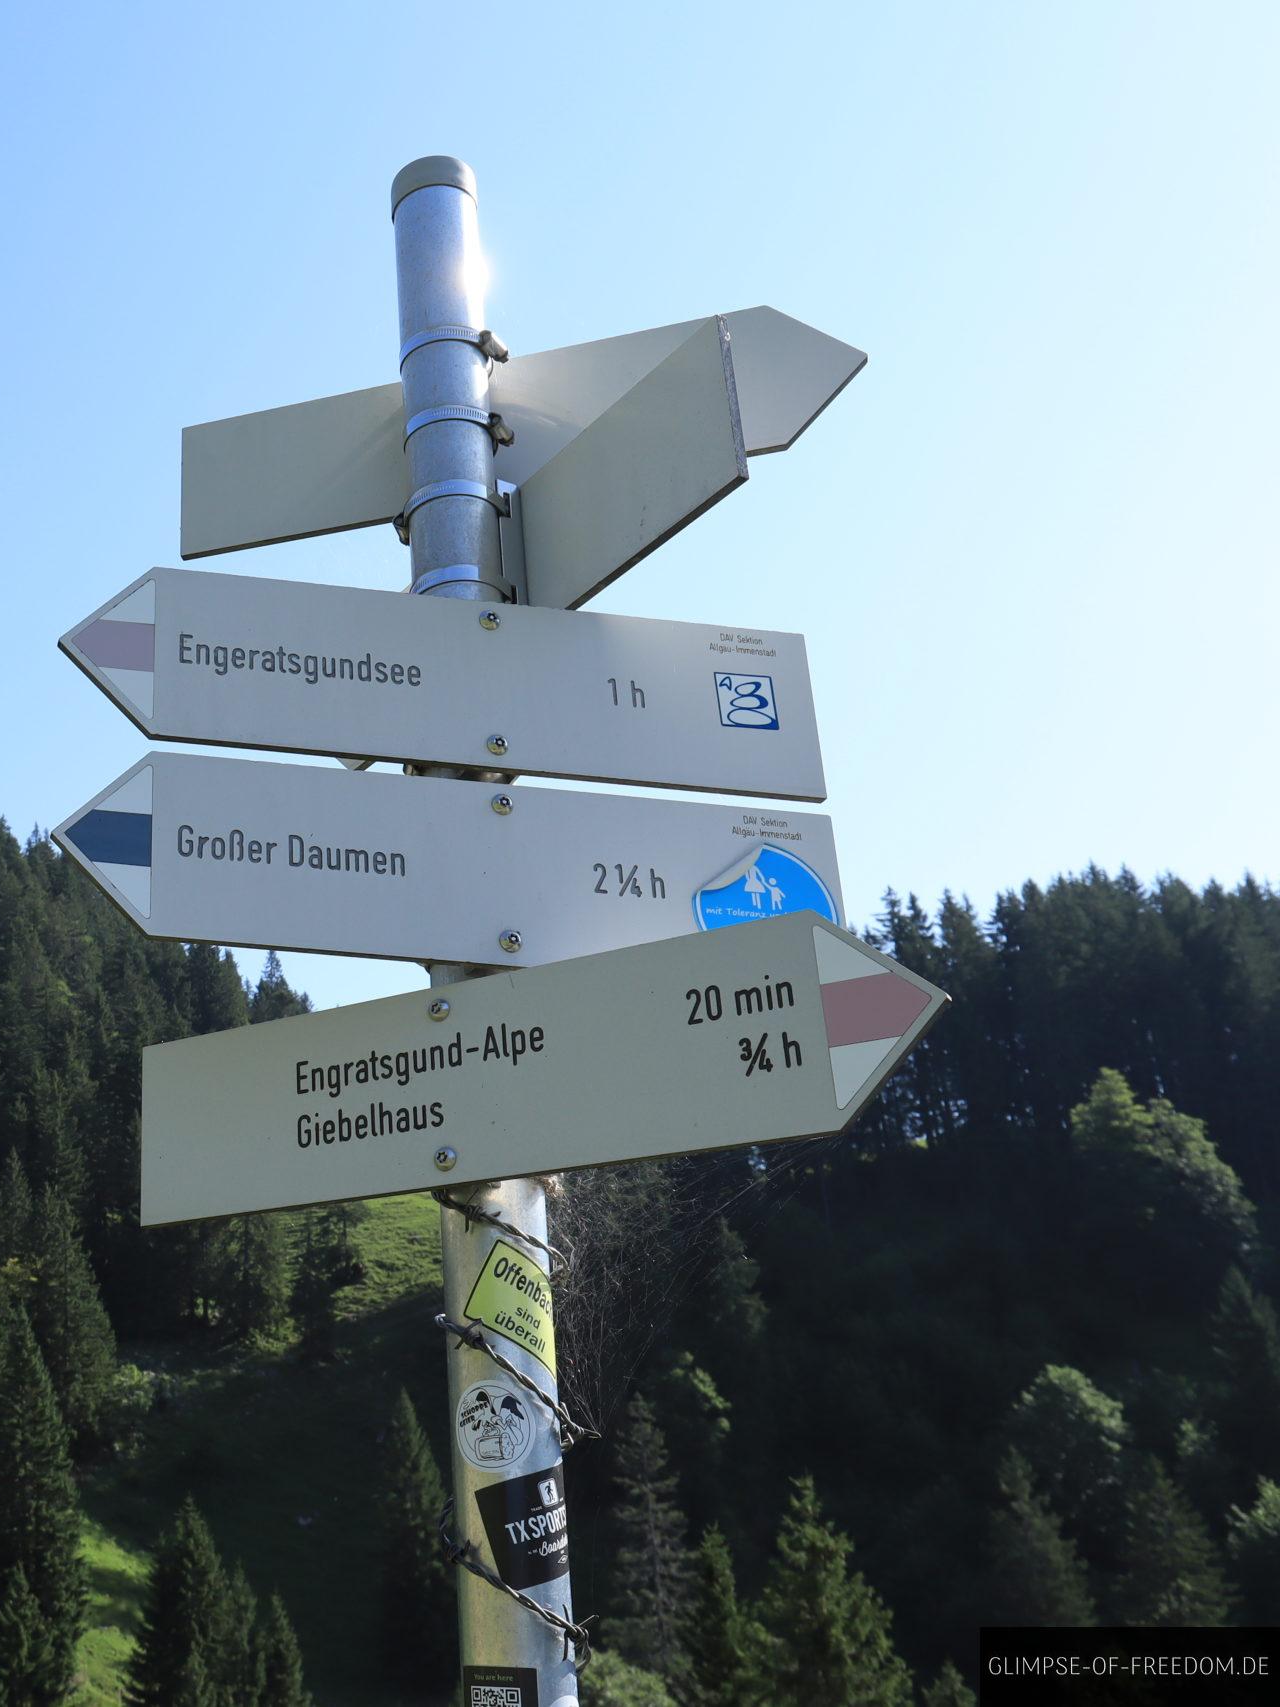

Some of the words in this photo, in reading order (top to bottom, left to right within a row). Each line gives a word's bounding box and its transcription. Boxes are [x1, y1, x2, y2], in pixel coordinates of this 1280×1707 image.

[719, 632, 734, 642] DAV
[737, 634, 763, 645] Sektion
[179, 633, 421, 687] Engeratsgundsee
[607, 677, 618, 706] 1
[630, 680, 646, 708] h
[742, 815, 758, 825] DAV
[761, 817, 788, 828] Sektion
[177, 824, 278, 864] Großer
[288, 834, 406, 877] Daumen
[650, 868, 666, 899] h
[706, 906, 722, 915] mit
[727, 908, 766, 918] Toleranz
[296, 1023, 545, 1098] Engratsgund-Alpe
[685, 985, 723, 1025] 20
[734, 975, 794, 1016] min
[297, 1102, 445, 1148] Giebelhaus
[781, 1031, 802, 1068] h
[493, 1257, 553, 1317] Offenbac
[494, 1310, 546, 1353] überall
[515, 1306, 541, 1330] sind
[497, 1673, 514, 1681] here
